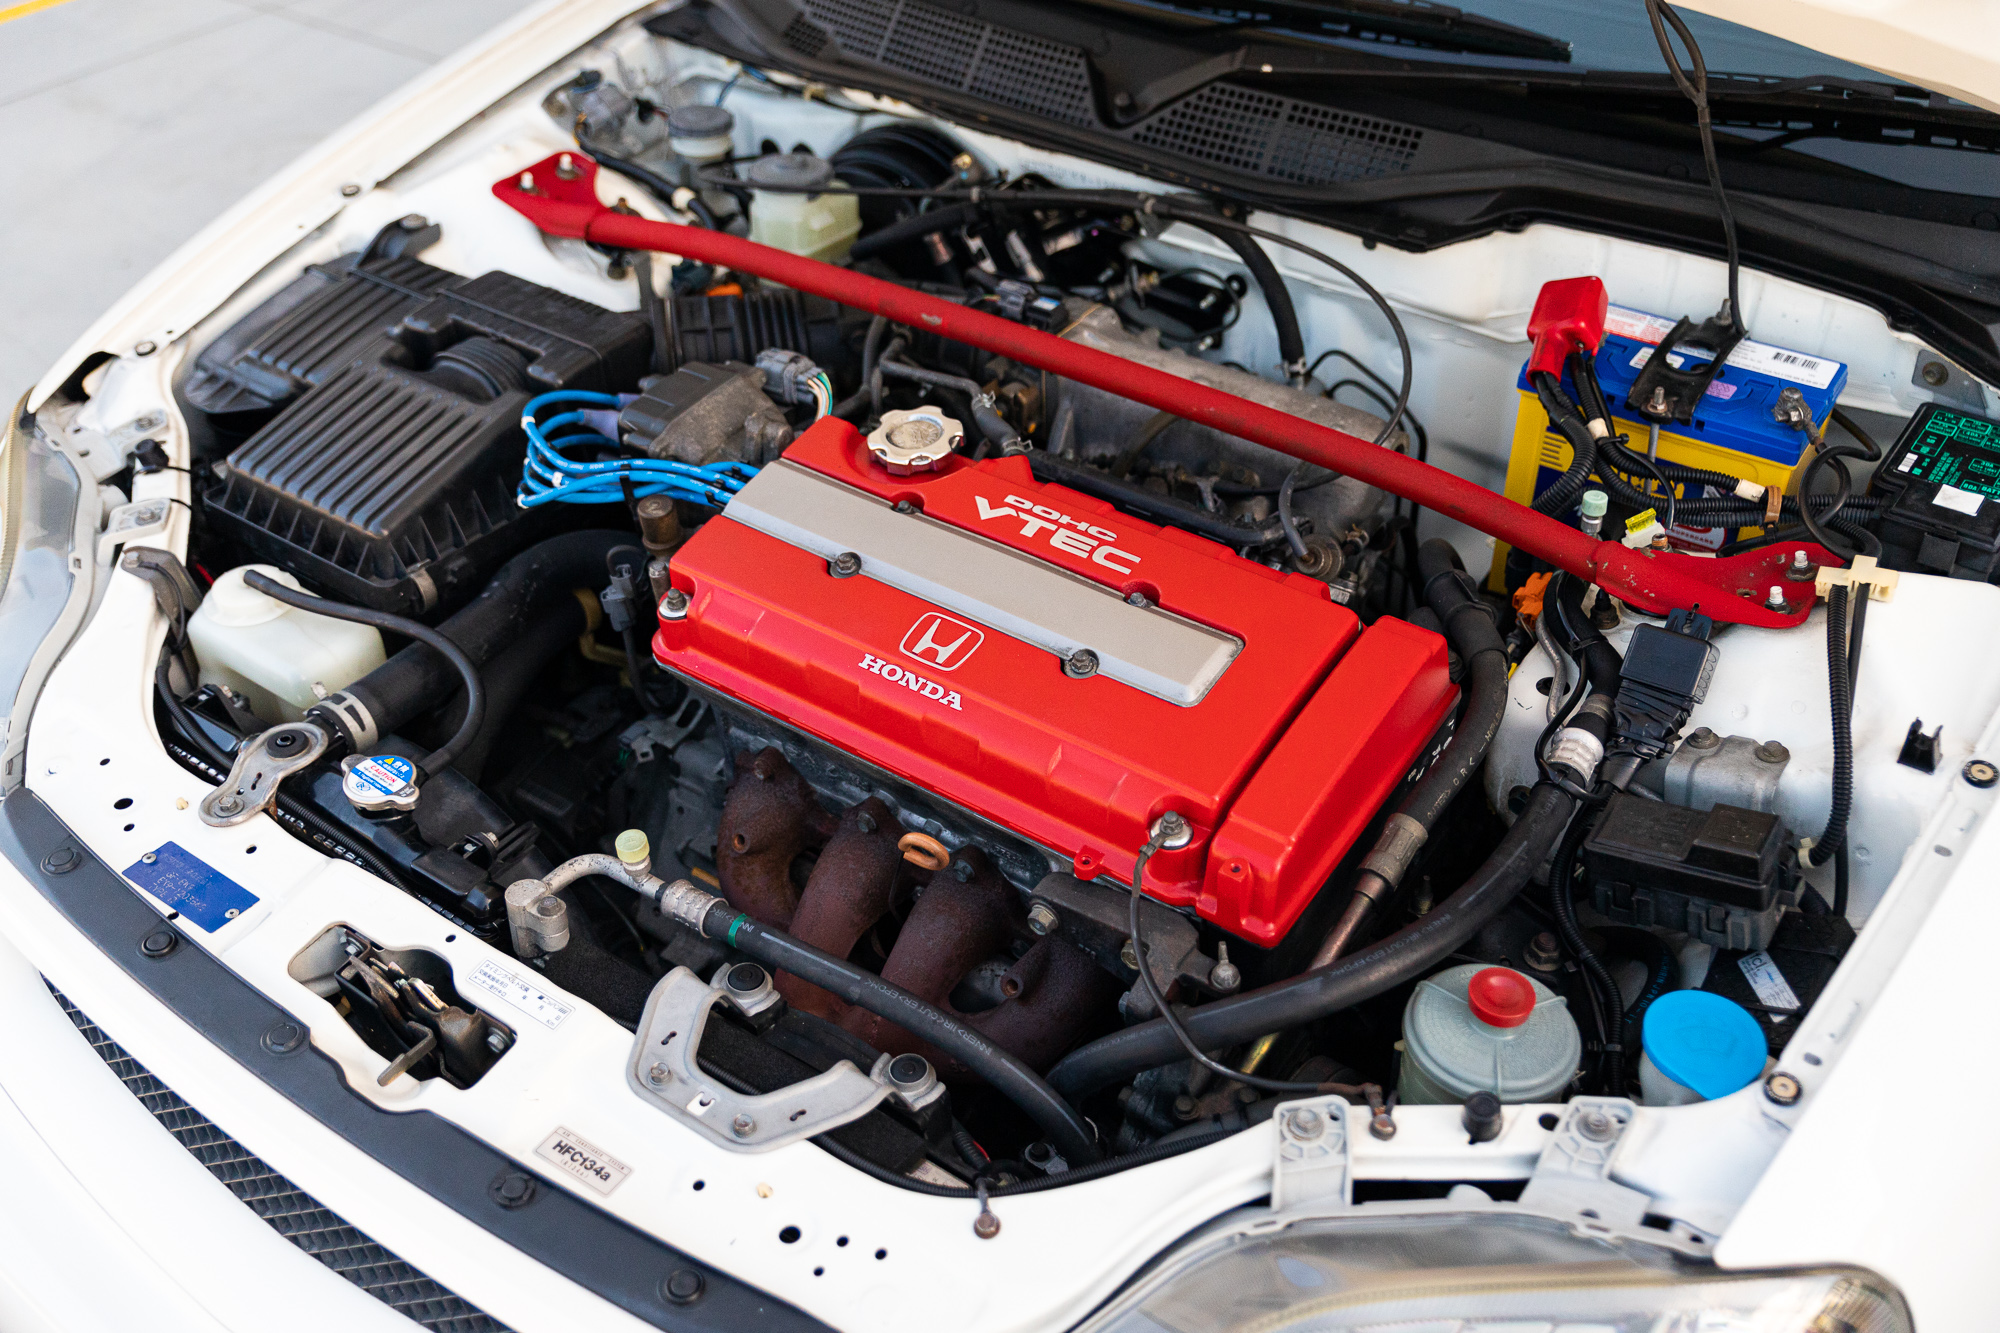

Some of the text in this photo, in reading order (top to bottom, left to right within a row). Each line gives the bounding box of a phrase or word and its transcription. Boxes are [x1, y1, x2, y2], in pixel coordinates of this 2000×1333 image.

[975, 495, 1142, 576] VTEC
[1003, 494, 1118, 542] DOHC
[858, 653, 963, 711] HONDA
[370, 765, 398, 783] CAUTION
[552, 1139, 612, 1182] HFC134a
